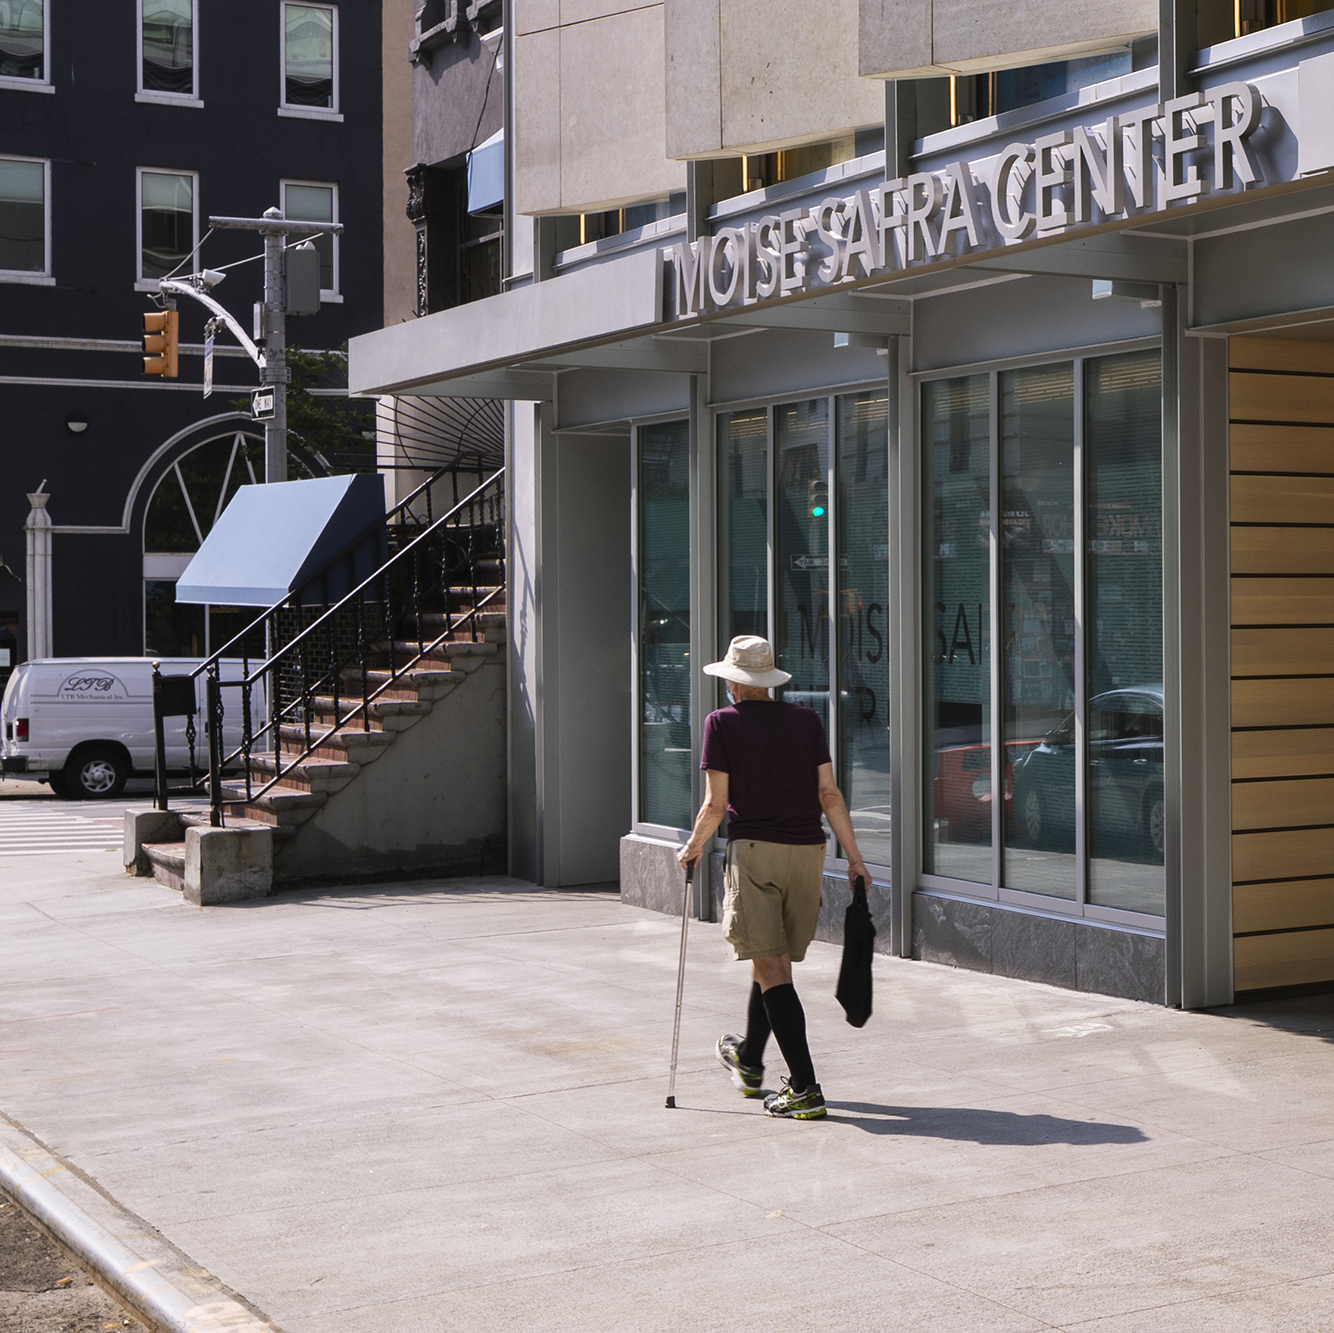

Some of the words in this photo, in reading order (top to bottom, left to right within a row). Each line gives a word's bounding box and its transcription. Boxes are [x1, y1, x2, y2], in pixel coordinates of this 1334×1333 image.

[674, 207, 809, 317] MOISE
[817, 160, 988, 283] SAFRA
[992, 80, 1262, 241] CENTER
